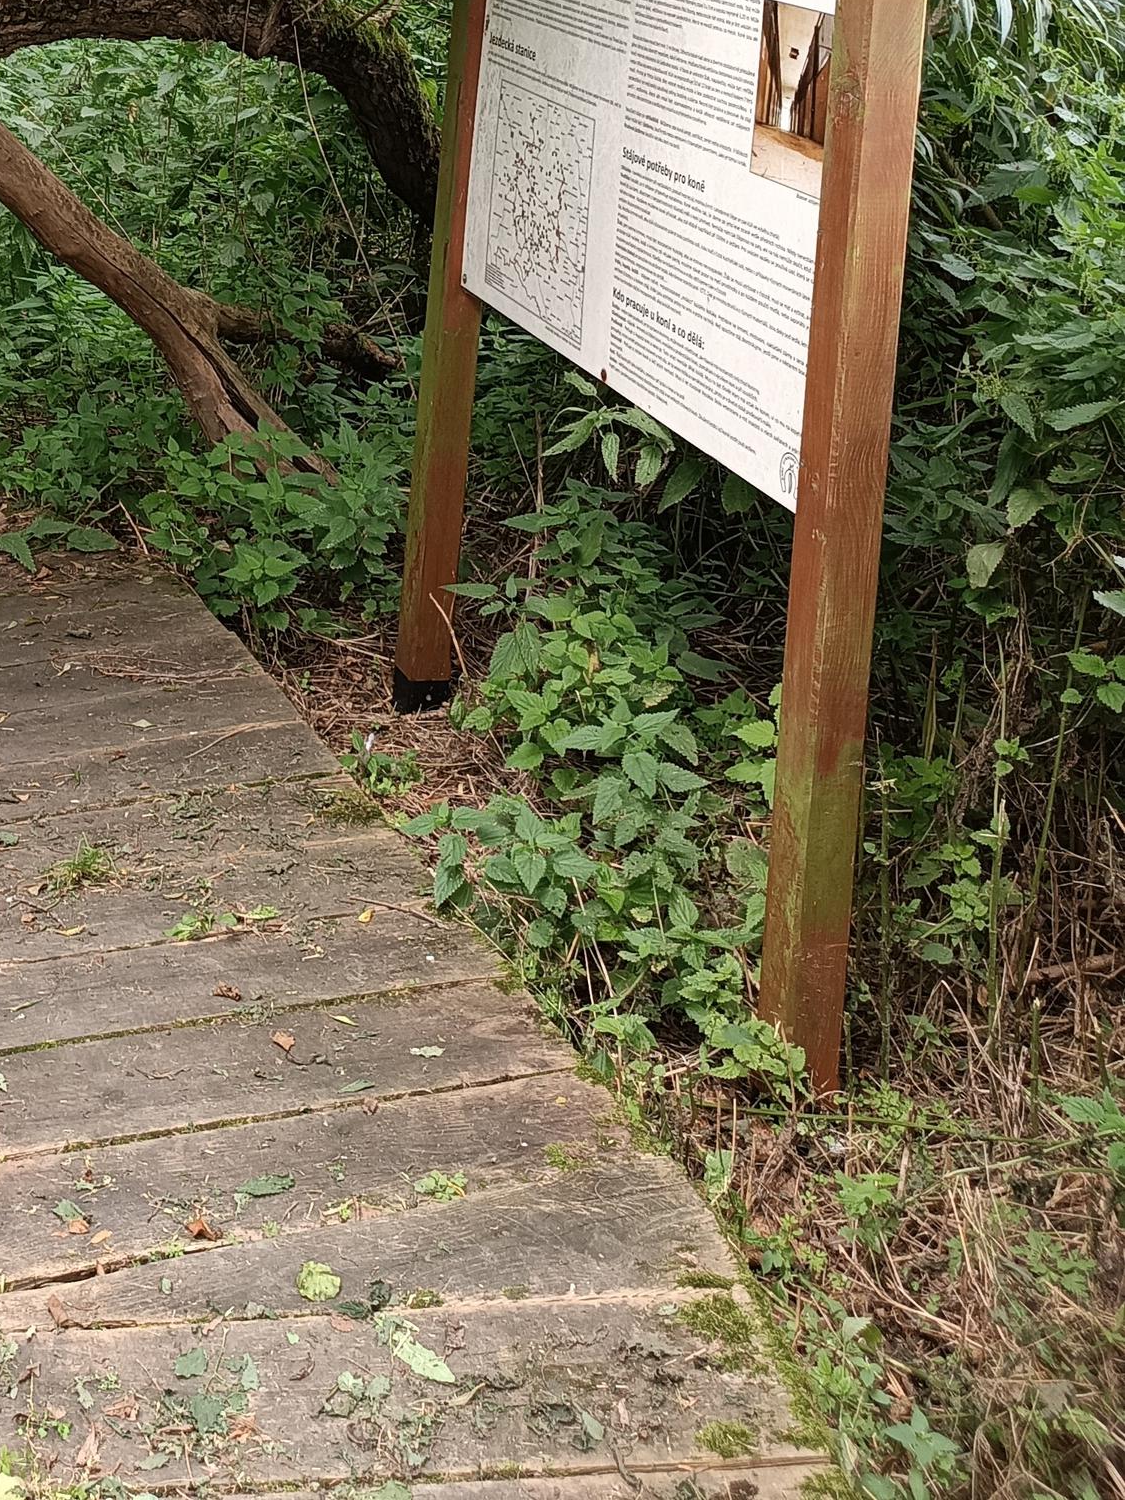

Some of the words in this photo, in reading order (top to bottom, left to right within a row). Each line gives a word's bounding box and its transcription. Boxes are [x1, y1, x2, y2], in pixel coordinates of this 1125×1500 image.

[646, 160, 673, 181] potřeby
[674, 172, 686, 184] pro
[687, 174, 706, 193] koně
[613, 287, 625, 302] Kdo
[626, 297, 649, 318] pracuje
[650, 311, 655, 320] u
[672, 323, 677, 333] a
[677, 327, 686, 339] co
